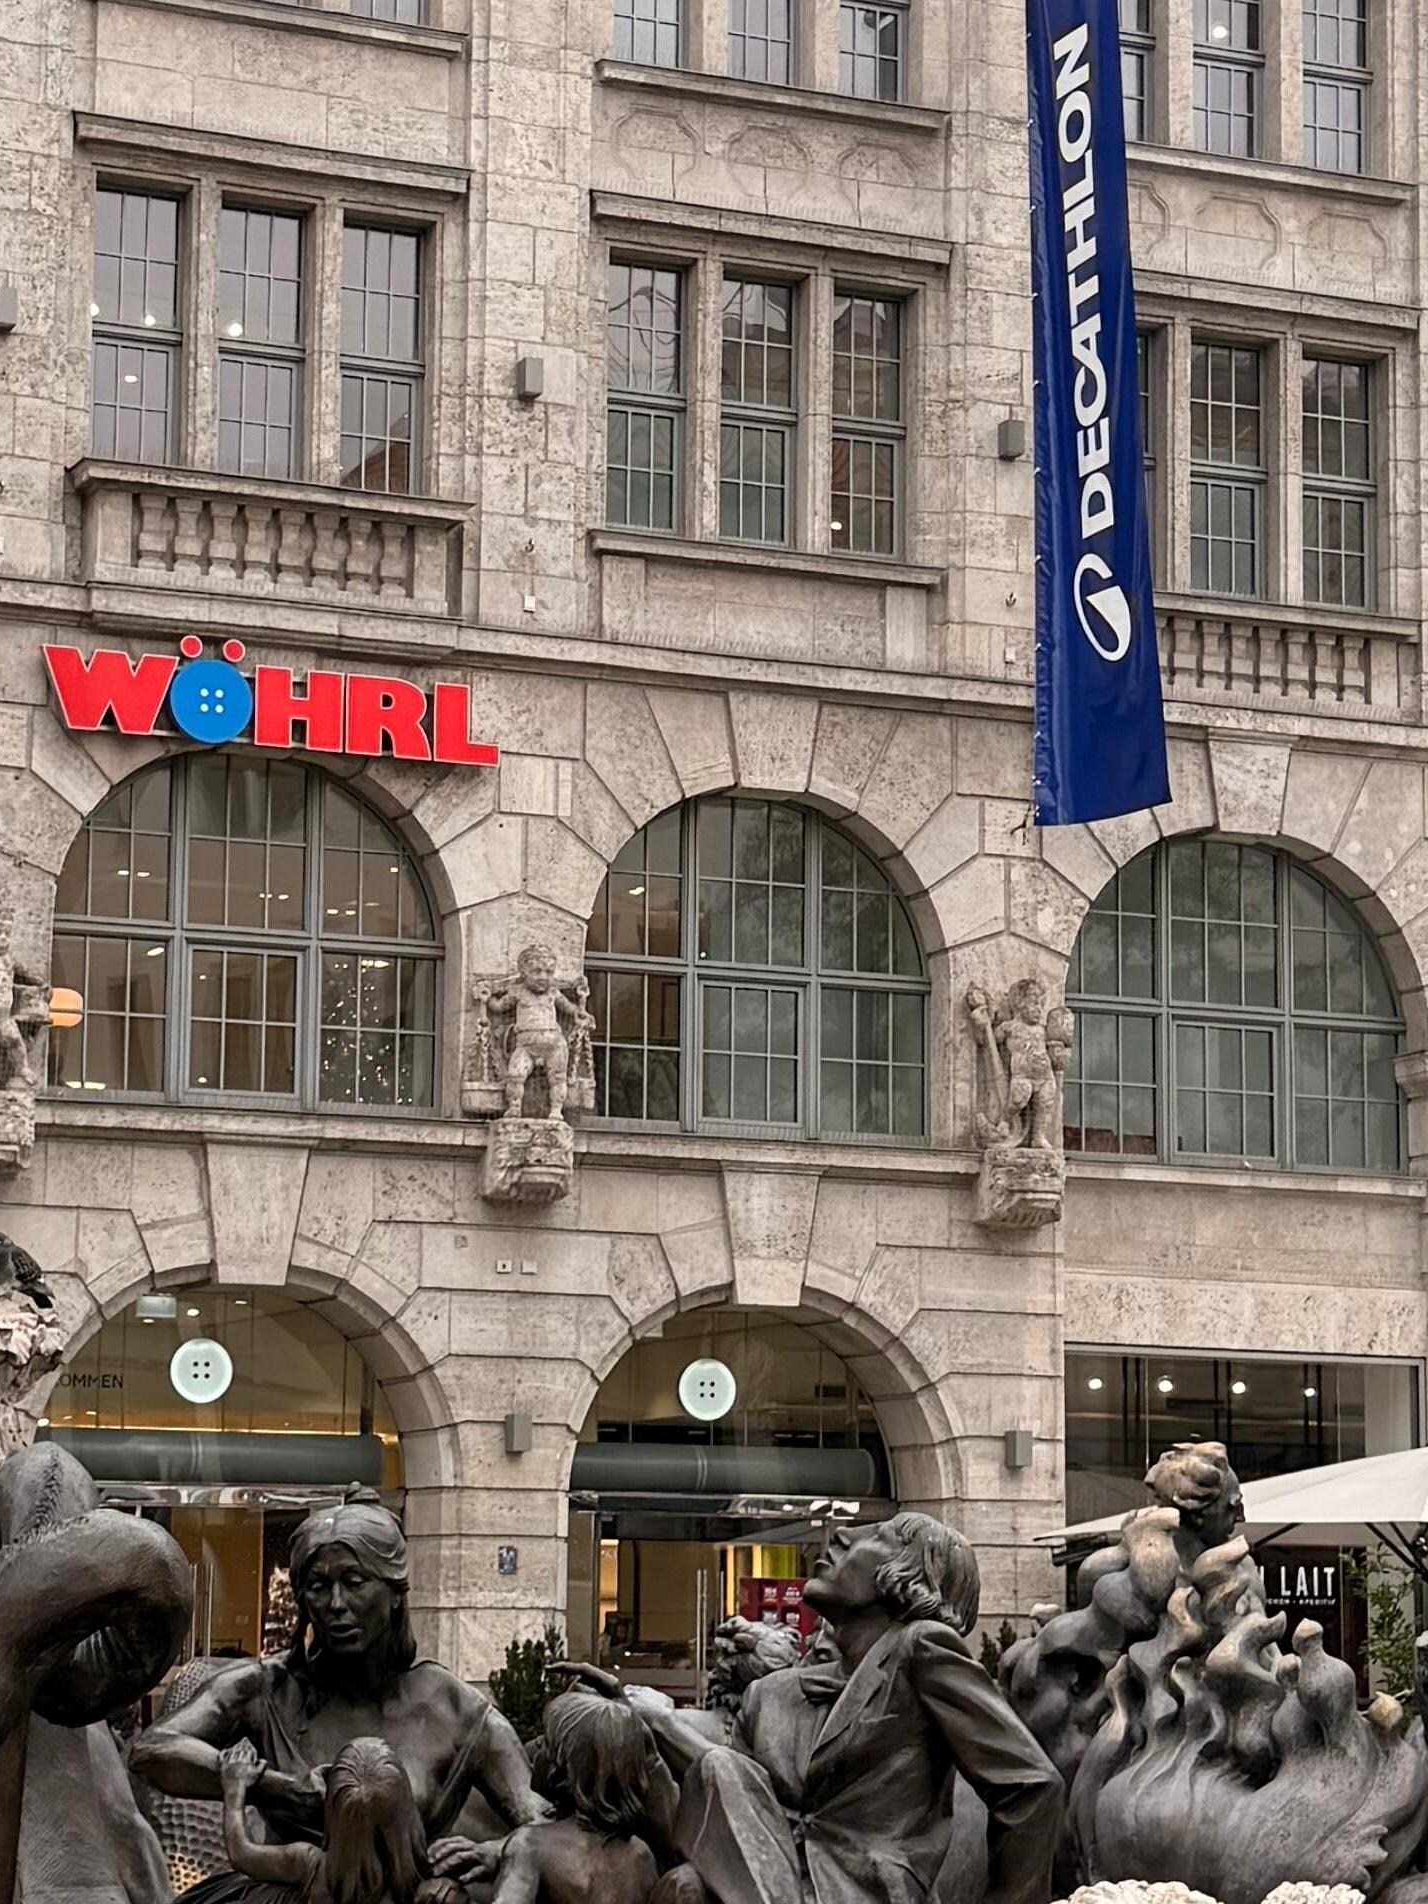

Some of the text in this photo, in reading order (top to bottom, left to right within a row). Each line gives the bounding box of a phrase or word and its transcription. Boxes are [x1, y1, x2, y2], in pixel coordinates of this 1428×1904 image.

[1054, 23, 1114, 539] DECATHLON
[43, 634, 501, 767] WÖHRL
[55, 1373, 124, 1389] OMMEN
[1280, 1565, 1335, 1597] LAIT
